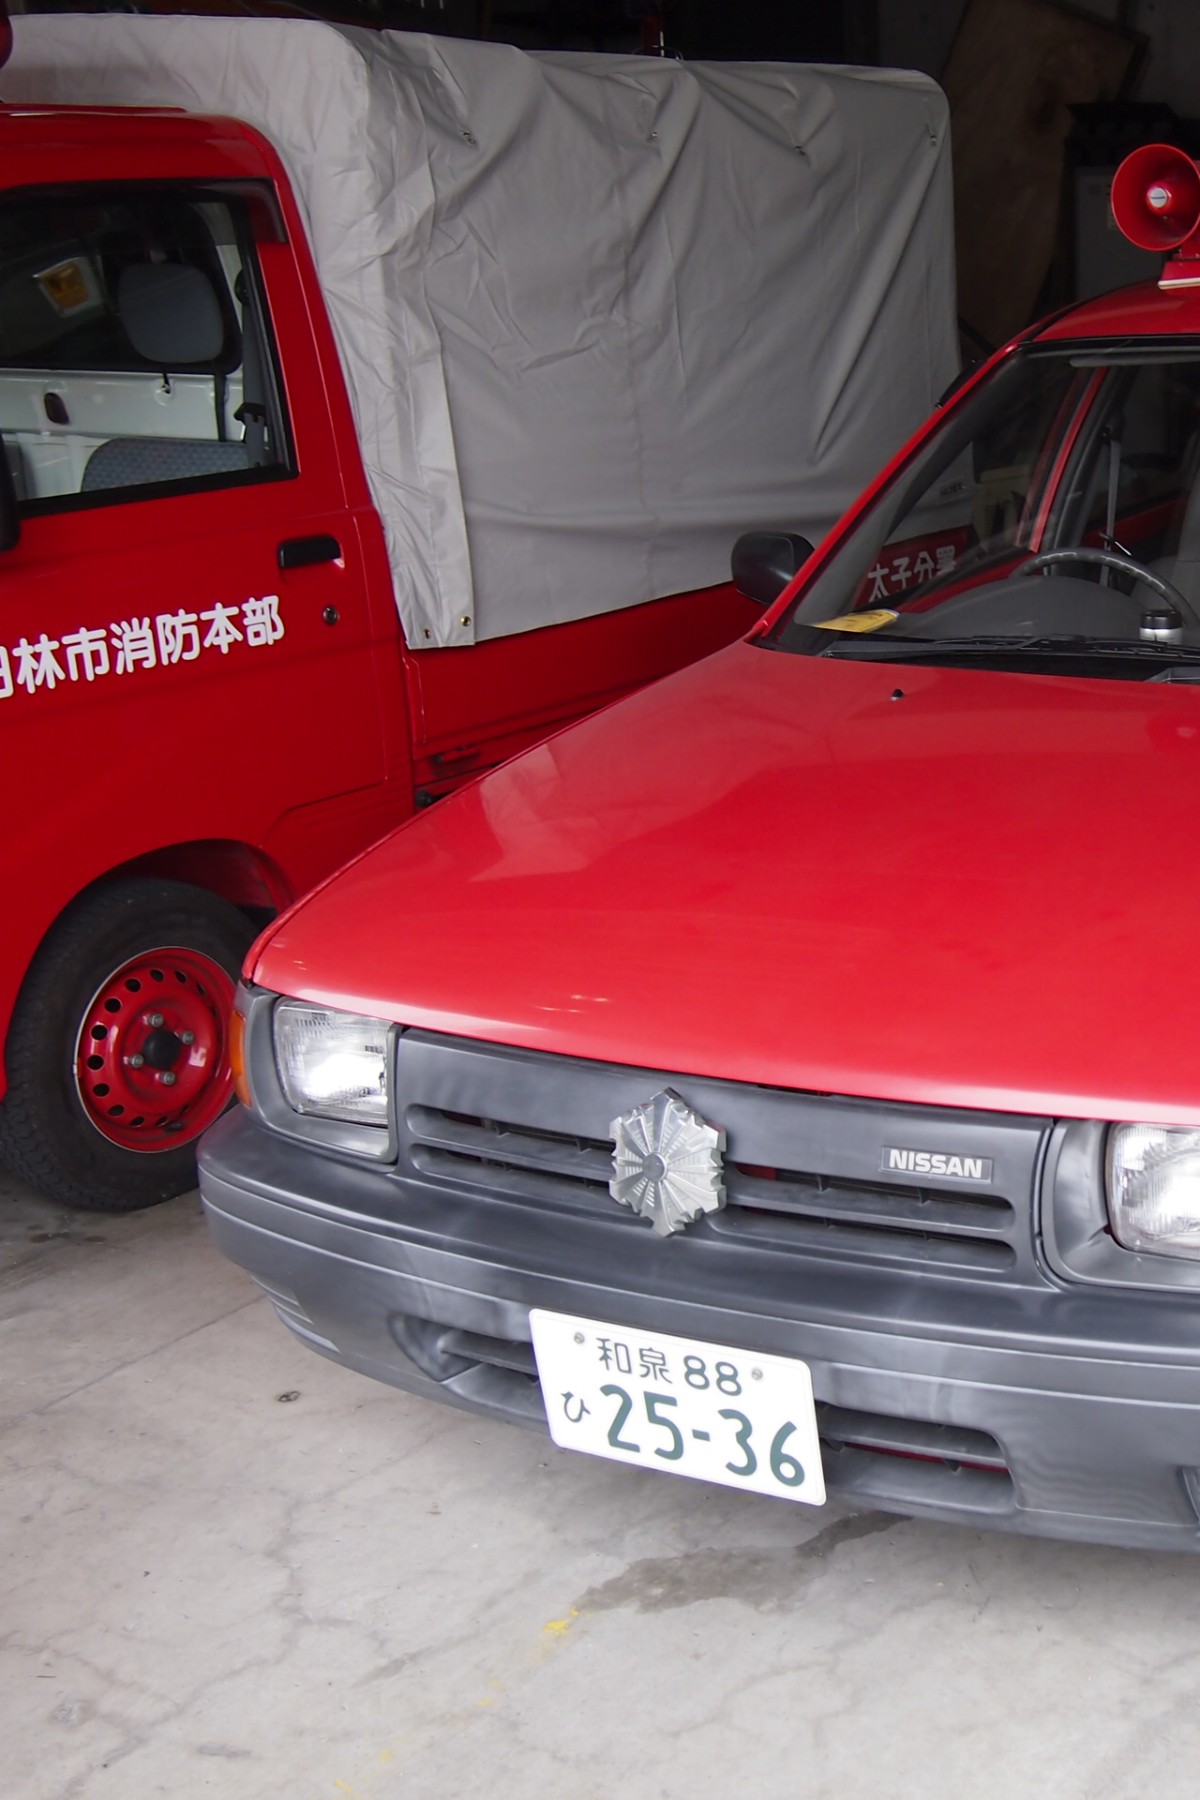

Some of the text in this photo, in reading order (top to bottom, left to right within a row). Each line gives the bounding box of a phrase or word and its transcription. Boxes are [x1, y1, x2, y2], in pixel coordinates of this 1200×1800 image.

[0, 595, 285, 699] 林市消防本部
[889, 1148, 983, 1179] NISSAN
[596, 1337, 743, 1397] 和泉 88
[561, 1384, 805, 1487] ひ 25-36
